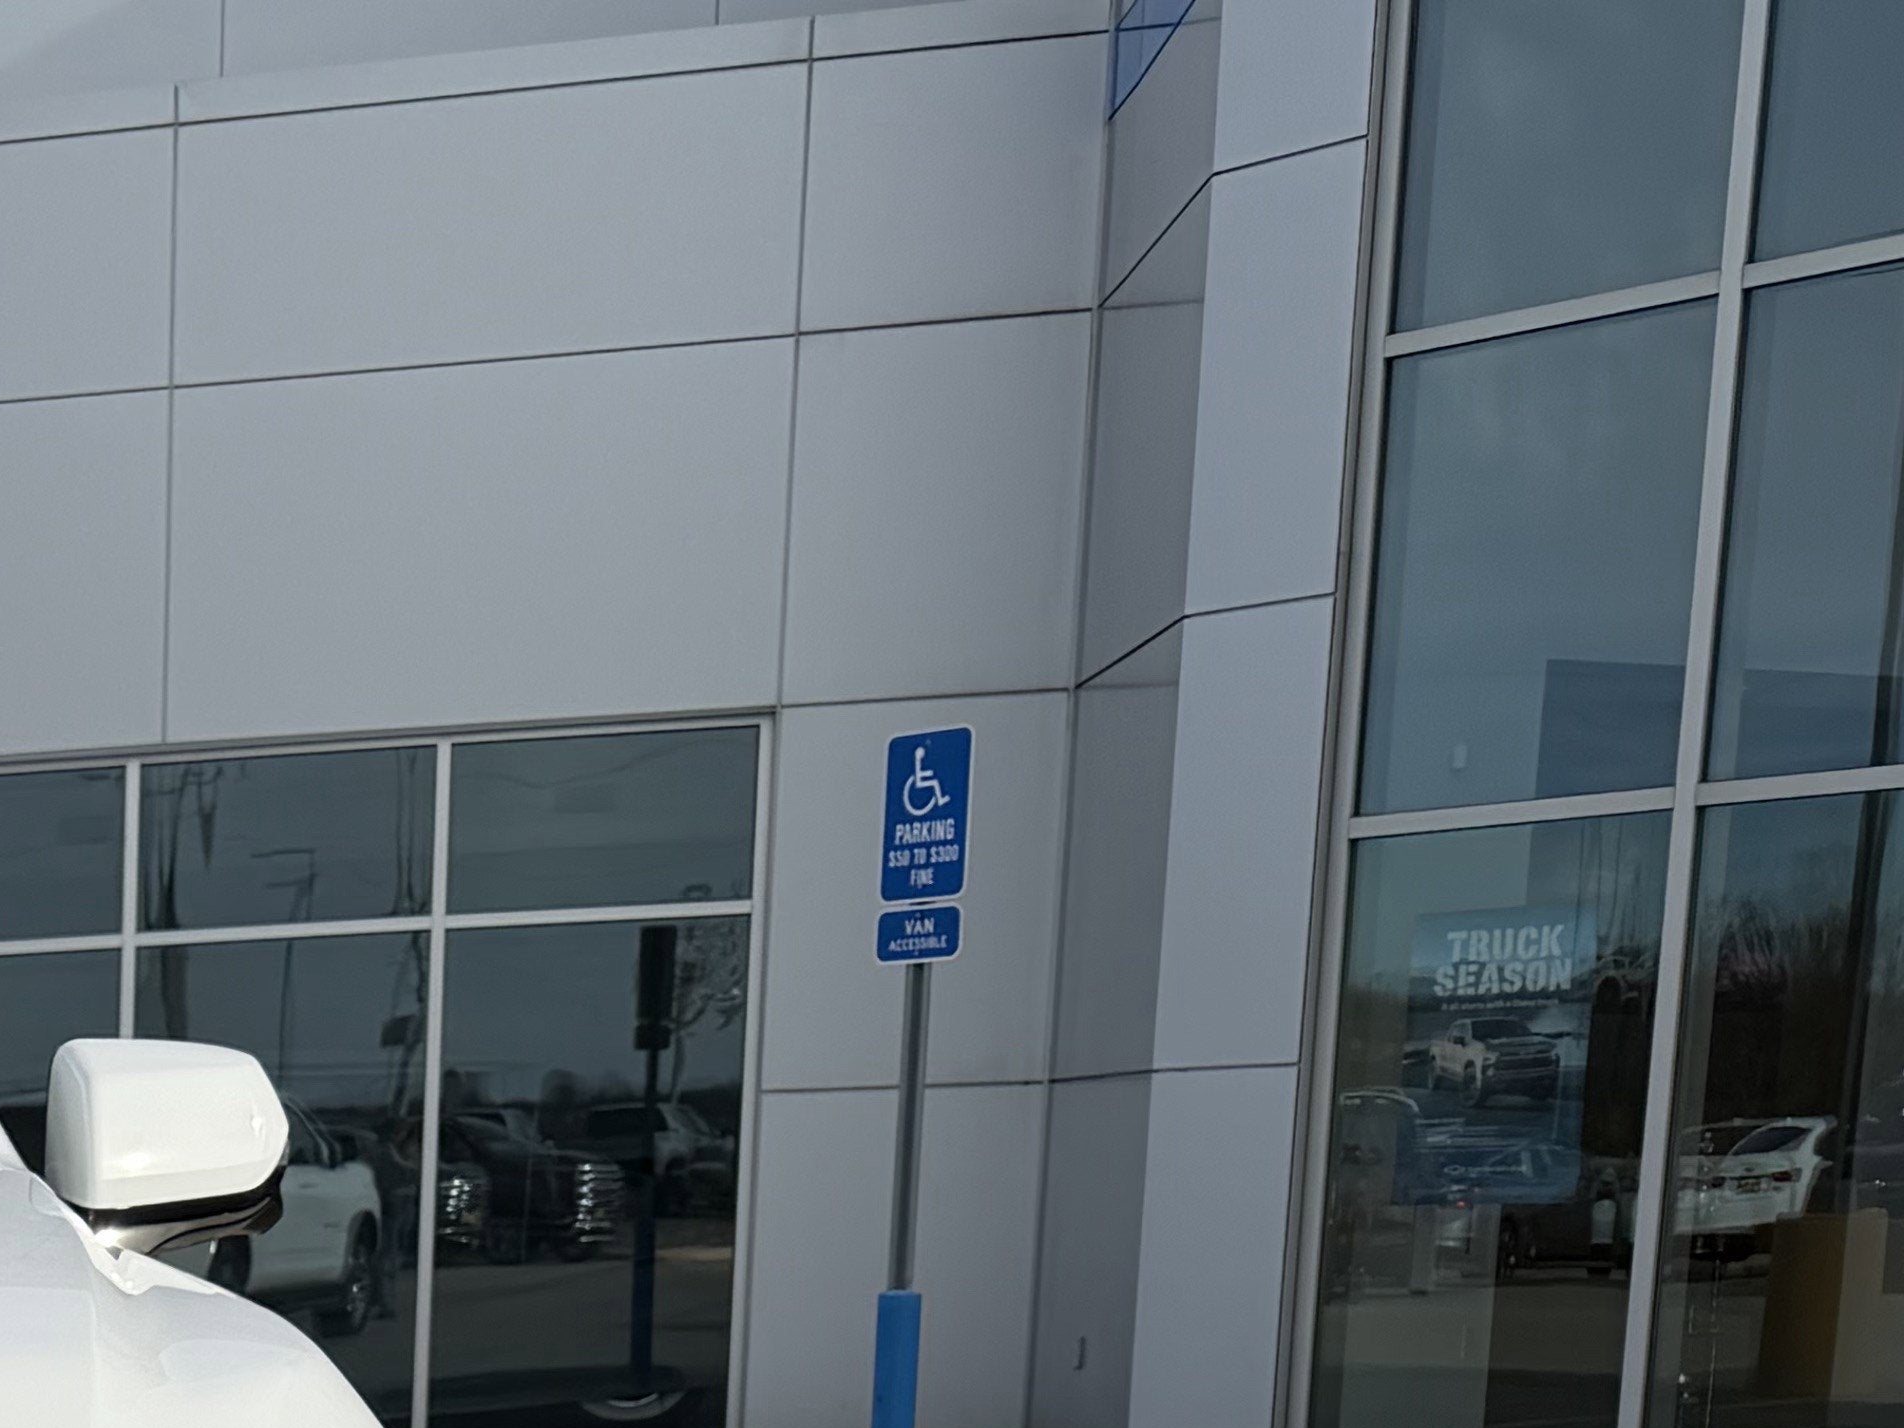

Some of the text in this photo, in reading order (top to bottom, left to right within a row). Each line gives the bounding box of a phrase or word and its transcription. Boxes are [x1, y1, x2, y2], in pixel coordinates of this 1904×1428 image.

[895, 819, 955, 844] PARKING
[889, 850, 910, 867] $50
[914, 847, 927, 865] TO
[911, 868, 934, 885] FINE
[906, 918, 934, 934] VAN
[889, 936, 947, 951] ACCESSIBLE
[1447, 924, 1565, 962] TRUCK
[1432, 957, 1572, 997] SEASON
